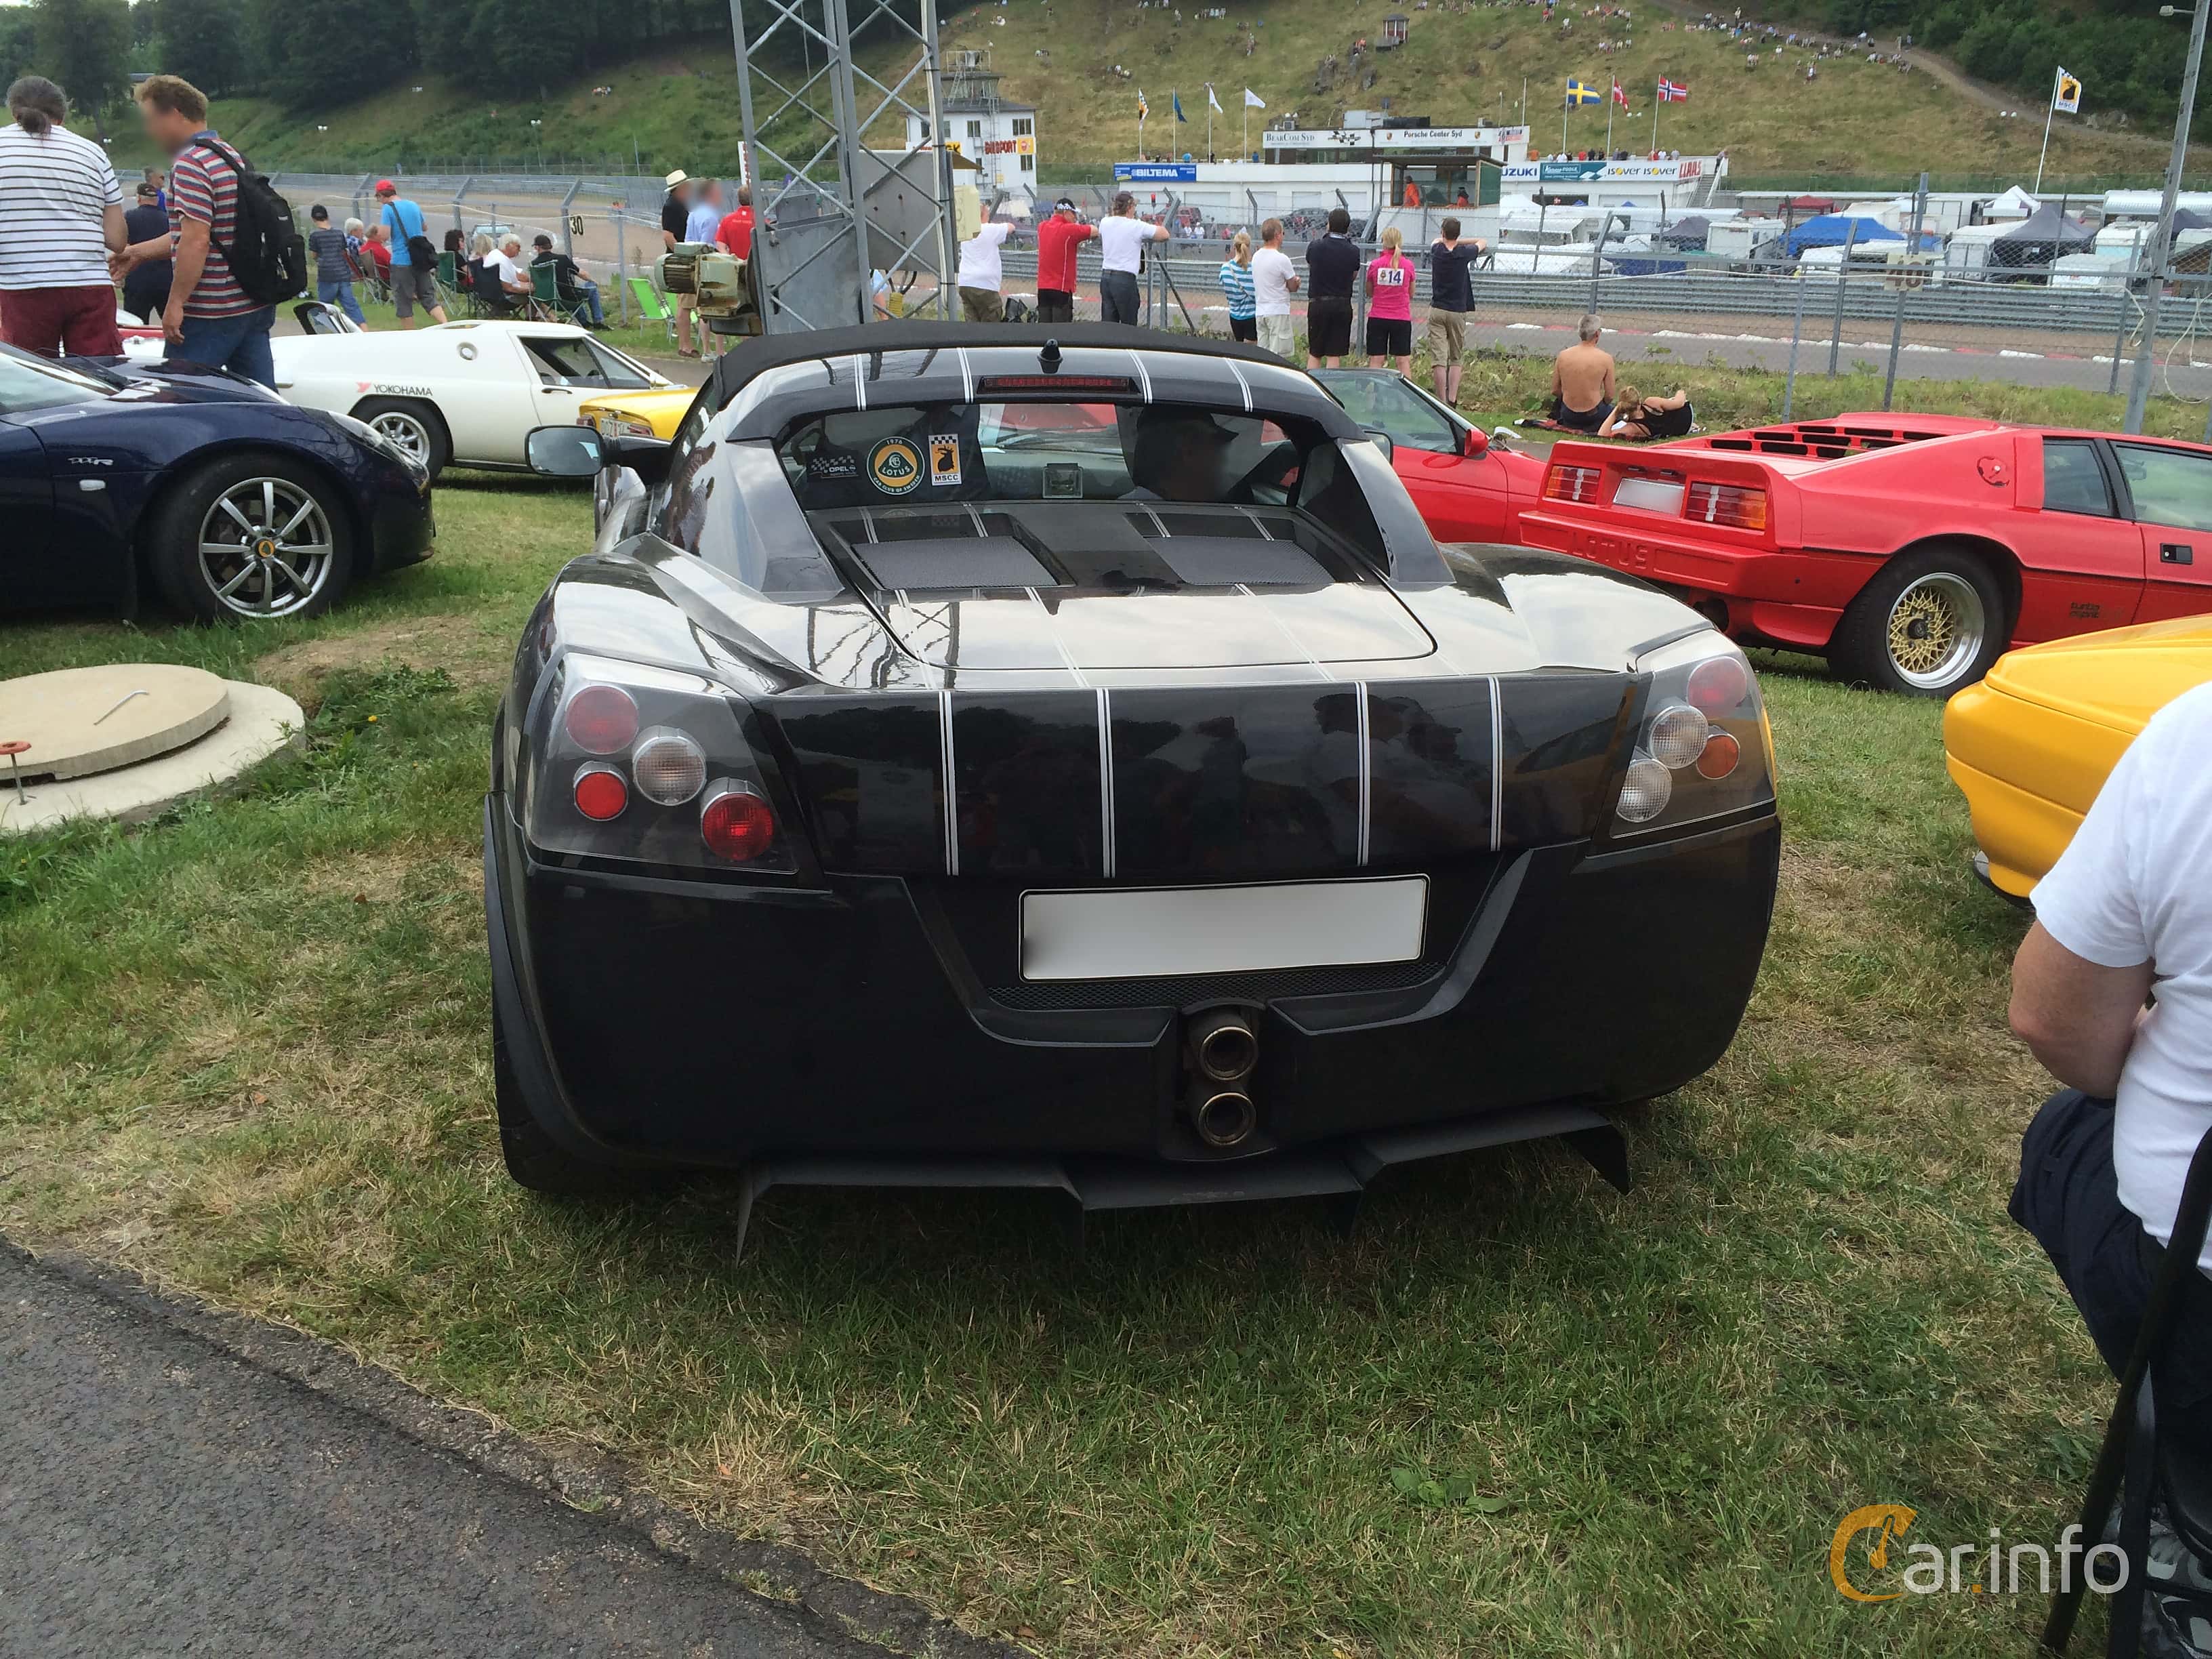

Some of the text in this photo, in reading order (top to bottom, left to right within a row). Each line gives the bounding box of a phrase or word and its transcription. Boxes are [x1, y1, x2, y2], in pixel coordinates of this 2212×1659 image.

[1404, 129, 1462, 138] Porsche Center Syd
[1136, 168, 1178, 177] BILTEMA
[1501, 168, 1537, 176] UZUKI
[570, 216, 583, 235] 30
[1389, 271, 1401, 283] 14
[1886, 260, 1923, 287] 40
[373, 384, 433, 396] YOKOHAMA
[882, 466, 910, 476] LOTUS
[1571, 531, 1648, 569] LOTUS
